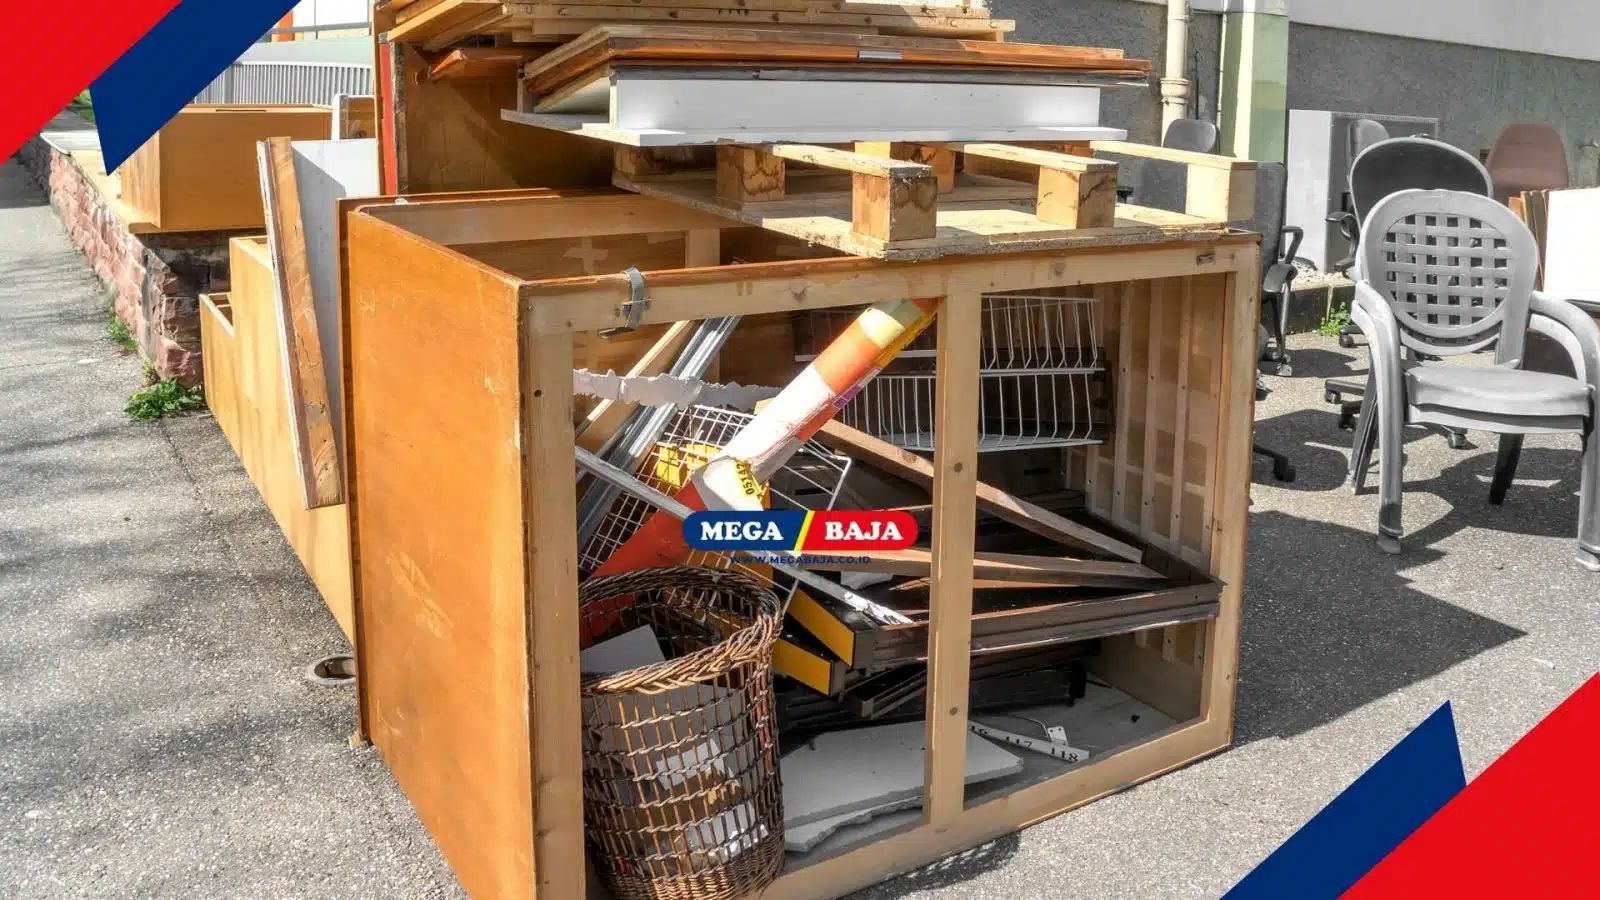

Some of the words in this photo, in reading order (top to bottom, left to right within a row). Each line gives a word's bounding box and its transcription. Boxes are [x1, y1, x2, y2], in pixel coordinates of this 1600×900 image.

[735, 461, 755, 495] 05142
[971, 725, 988, 735] 16
[1006, 736, 1032, 748] 117
[1051, 747, 1078, 762] 118
